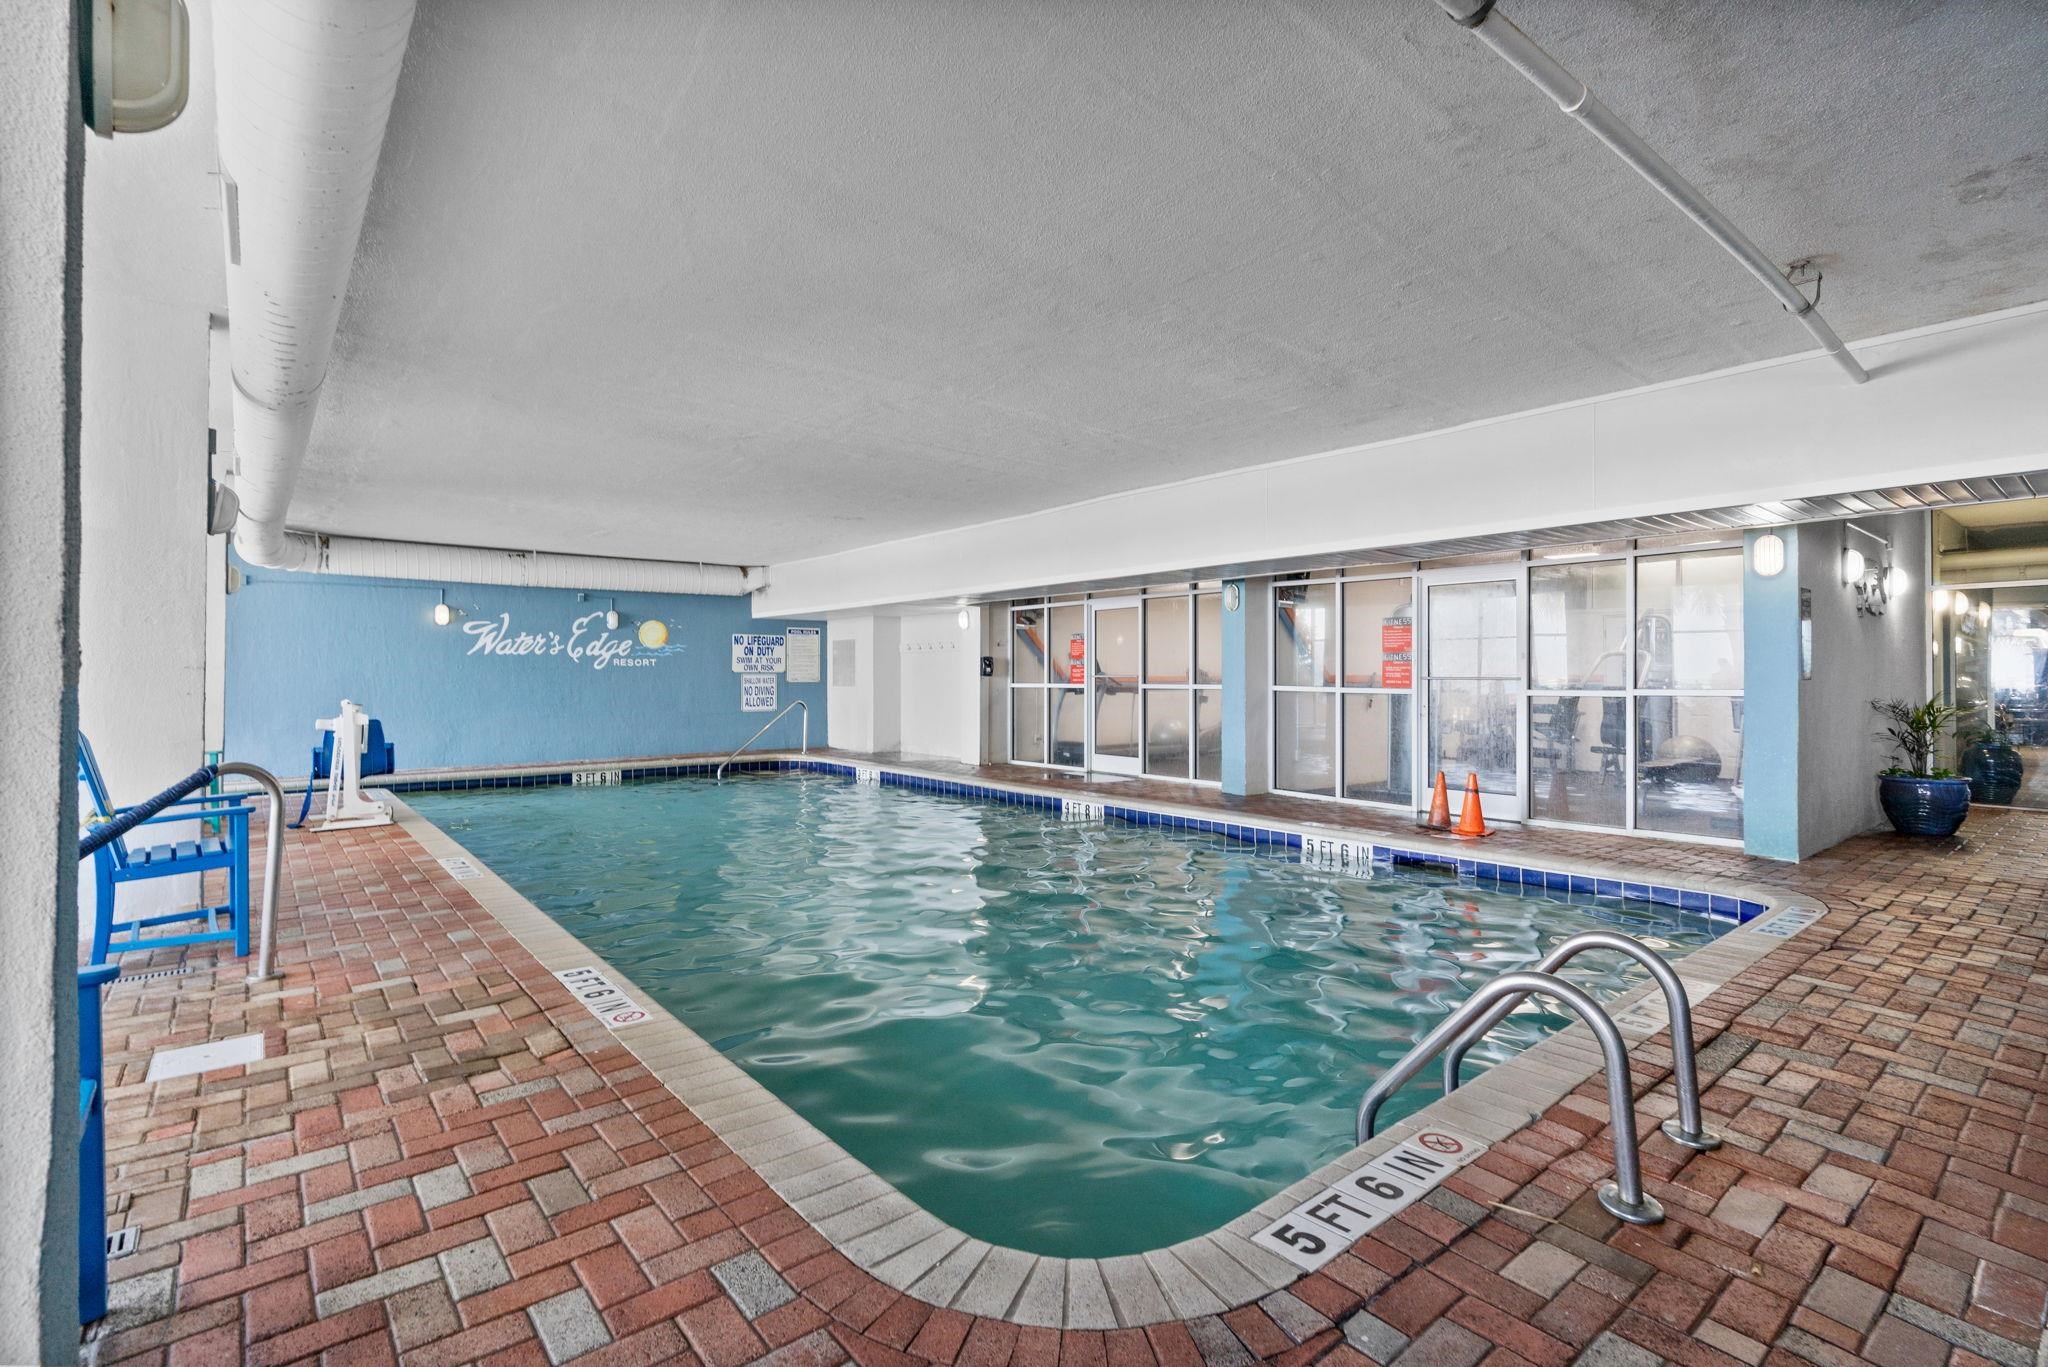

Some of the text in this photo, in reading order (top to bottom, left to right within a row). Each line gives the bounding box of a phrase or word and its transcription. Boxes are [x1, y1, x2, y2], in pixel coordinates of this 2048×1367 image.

[462, 611, 633, 670] Water's Edge
[734, 635, 784, 646] NO LIFEGUARD
[744, 646, 775, 656] ON DUTY
[613, 658, 657, 667] RESORT
[736, 656, 753, 664] SWIM
[762, 677, 775, 685] WATER
[744, 686, 775, 696] NO DIVING
[744, 696, 775, 707] ALLOWED
[576, 773, 582, 783] 3
[586, 772, 597, 784] FT
[610, 771, 620, 783] IN
[1072, 802, 1082, 814] FT
[1094, 805, 1103, 818] IN
[1320, 840, 1334, 856] FT
[563, 969, 632, 1013] 5 FT 6 IN
[1271, 1150, 1444, 1254] 5 FT 6 IN
